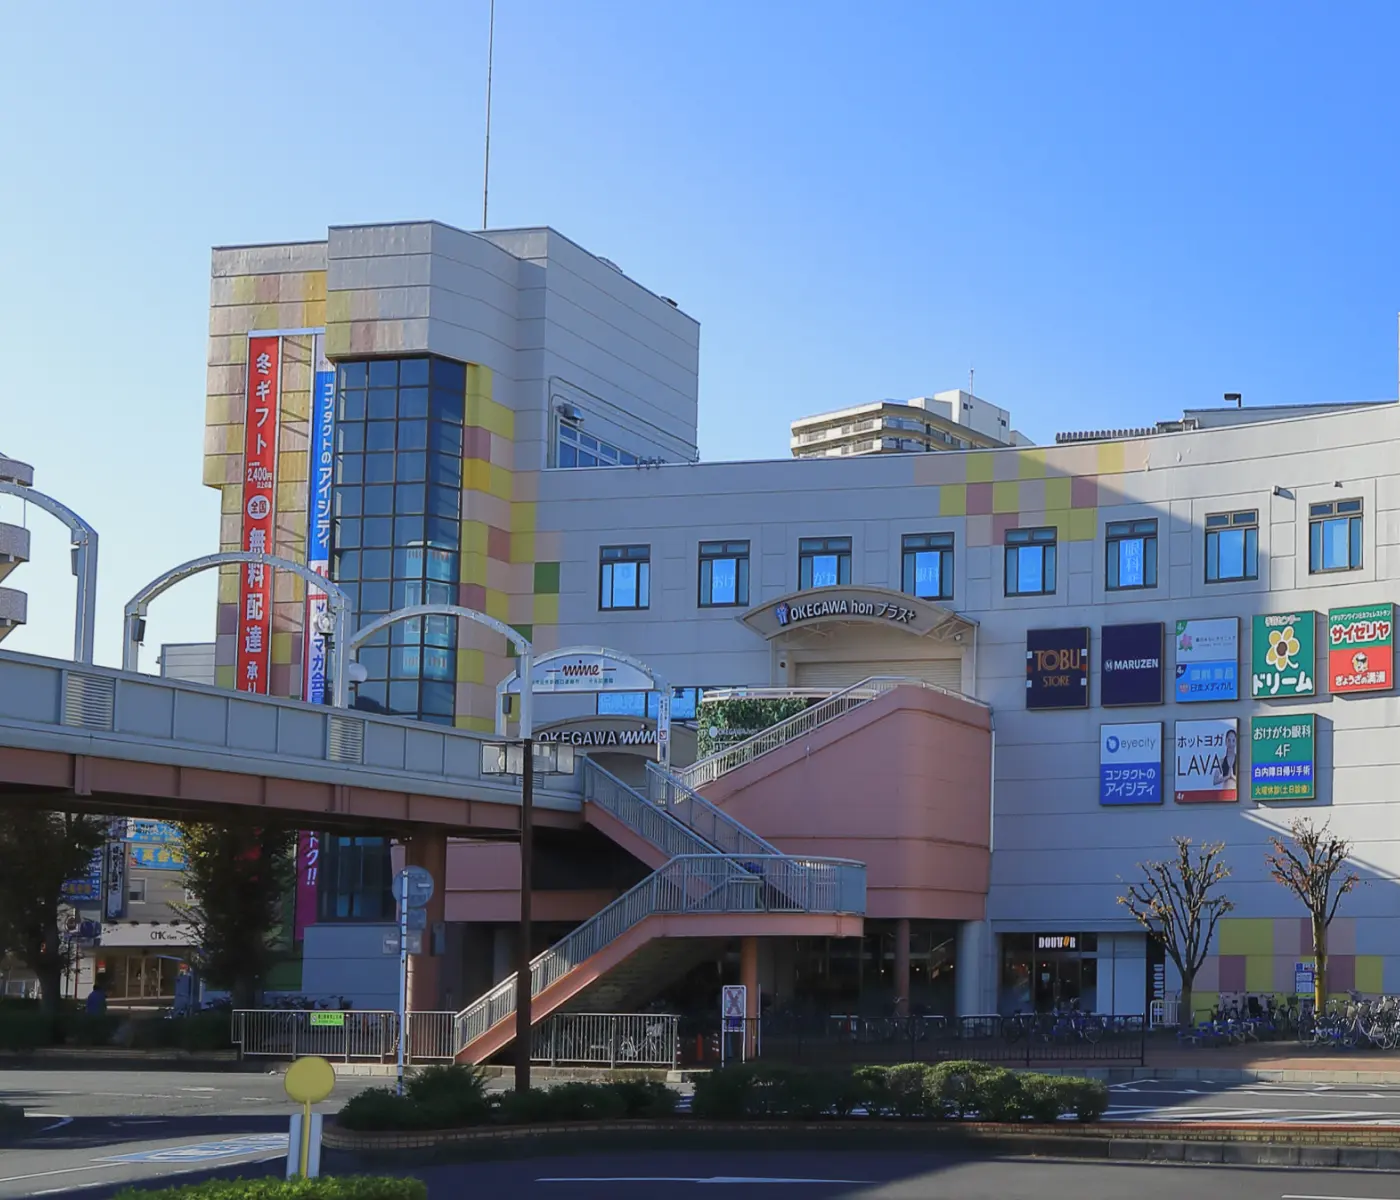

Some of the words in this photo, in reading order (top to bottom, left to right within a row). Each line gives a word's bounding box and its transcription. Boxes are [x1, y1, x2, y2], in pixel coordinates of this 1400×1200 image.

[255, 352, 272, 455] 冬ギフト
[317, 383, 333, 548] コンタクトのアイシティ
[250, 500, 267, 514] 全国
[790, 599, 848, 622] OKEGAWA
[851, 599, 874, 616] hon
[1331, 621, 1391, 644] サイゼリヤ
[562, 660, 600, 676] mine
[1034, 648, 1080, 672] TOBU
[1114, 658, 1159, 671] MARUZEN
[1042, 675, 1070, 688] STORE
[1252, 671, 1313, 695] ドリーム
[619, 723, 657, 744] min
[1177, 733, 1223, 748] ホットヨガ
[1253, 725, 1311, 741] おけがわ眼科
[1120, 737, 1156, 749] eyecity
[1275, 744, 1291, 758] 4F
[1177, 754, 1223, 776] LAVA
[1254, 765, 1311, 778] 白内障日帰り手術
[1104, 768, 1156, 781] コンタクトの
[1105, 781, 1155, 797] アイシティ
[1038, 935, 1076, 949] DOUTOR
